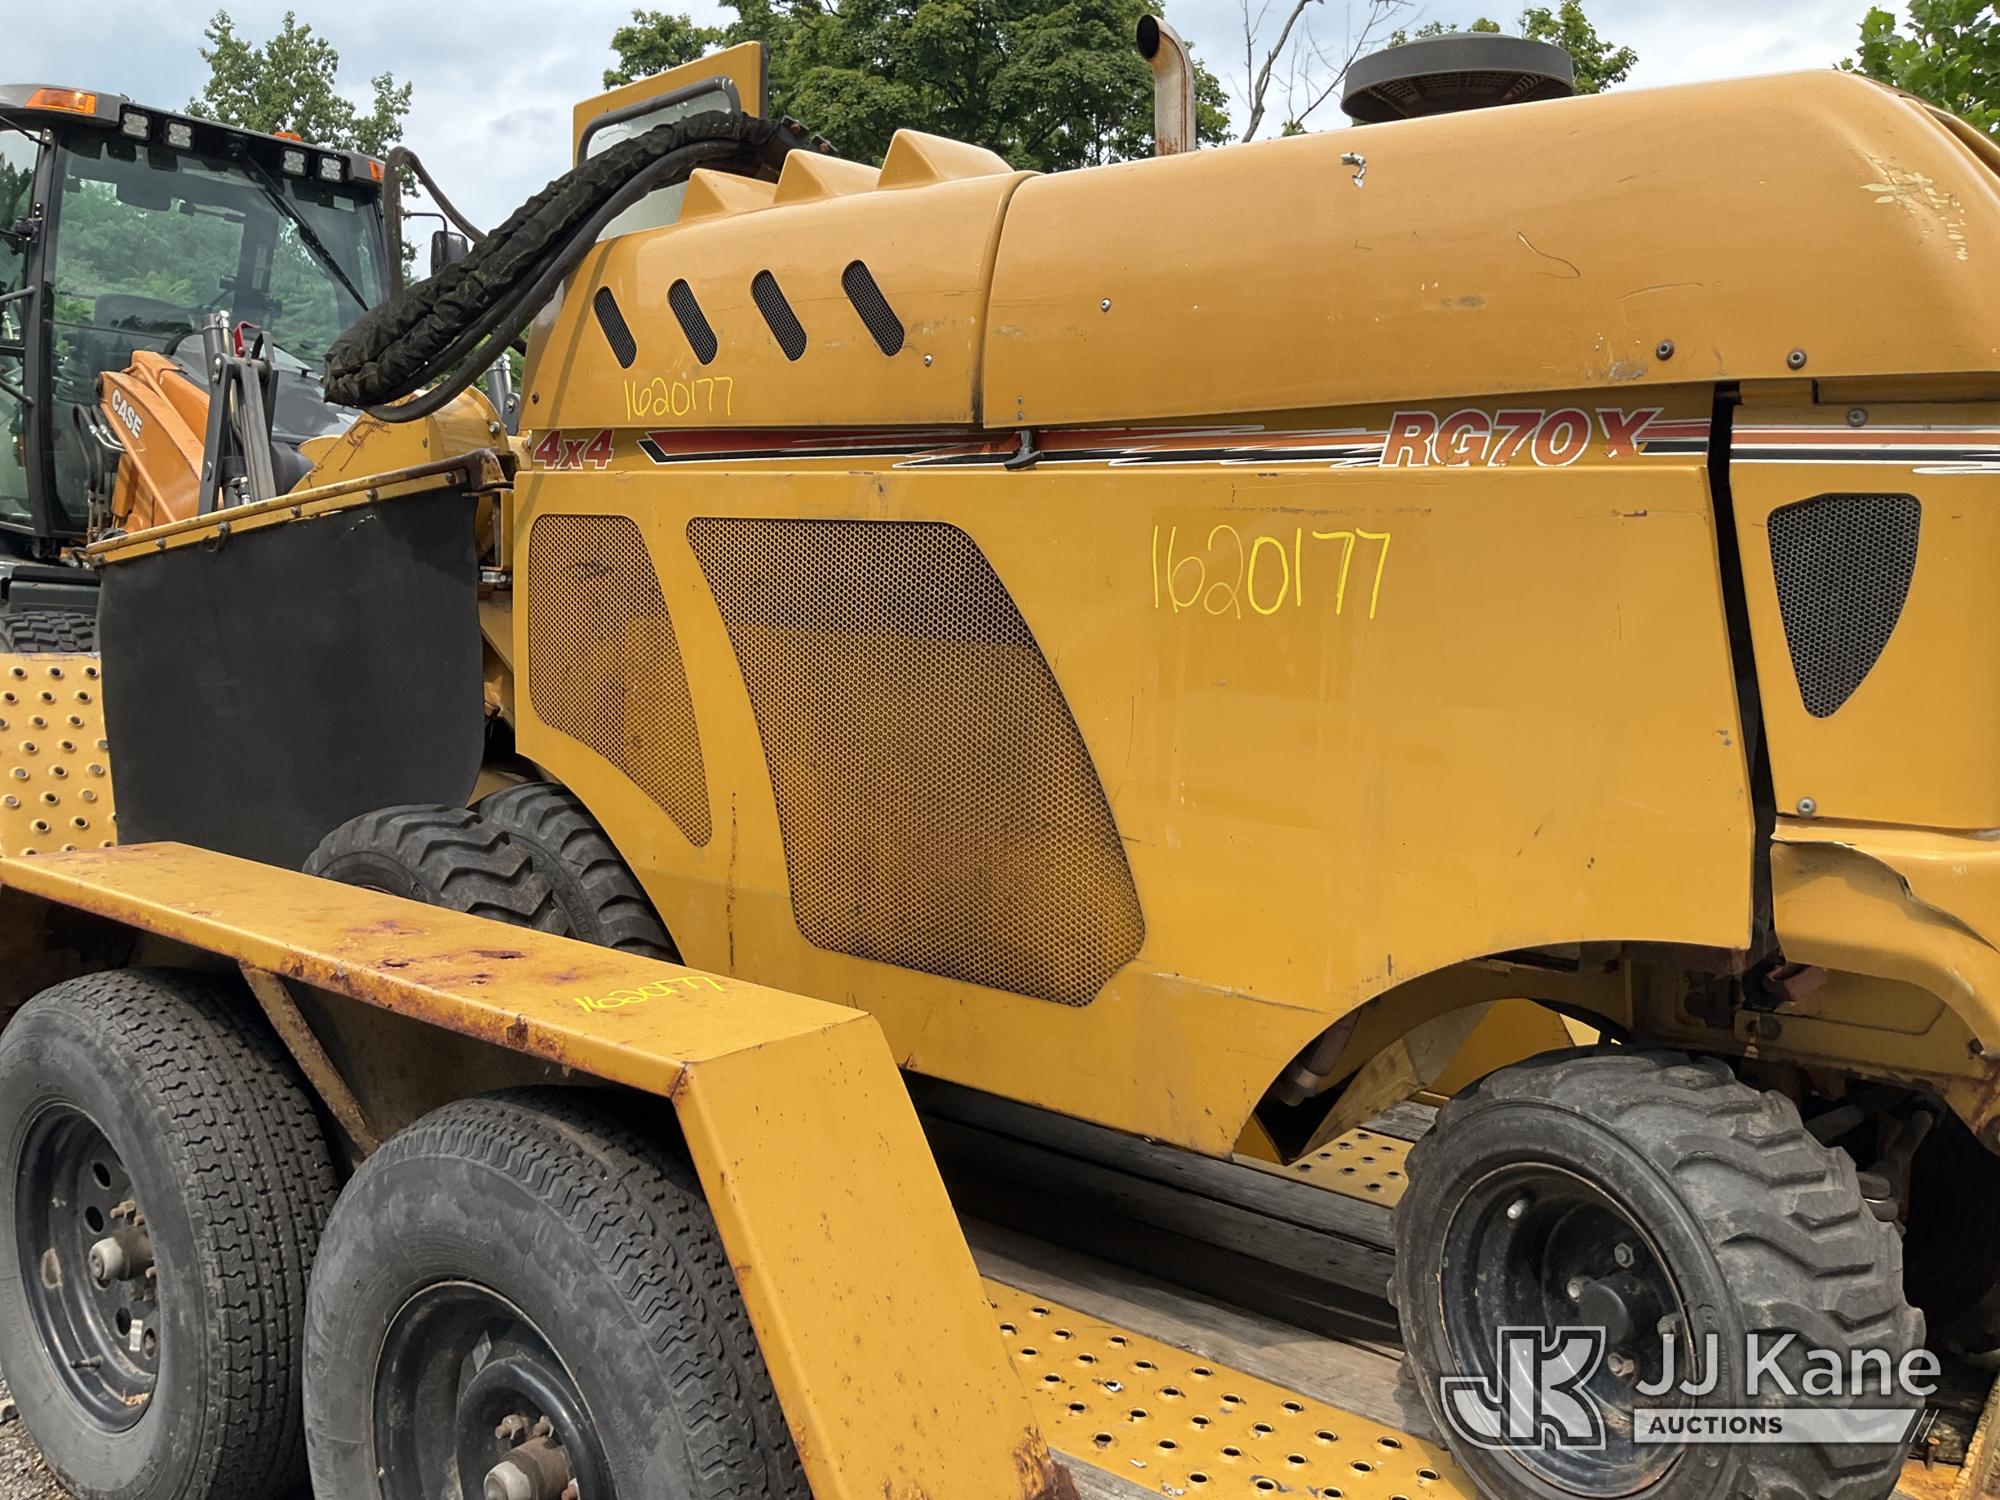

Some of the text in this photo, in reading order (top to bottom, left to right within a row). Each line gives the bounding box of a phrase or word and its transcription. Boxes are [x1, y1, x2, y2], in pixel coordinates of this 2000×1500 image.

[111, 388, 143, 439] CASE
[624, 376, 734, 421] 1620177
[532, 429, 614, 470] 4x4
[1152, 524, 1391, 620] 1620177
